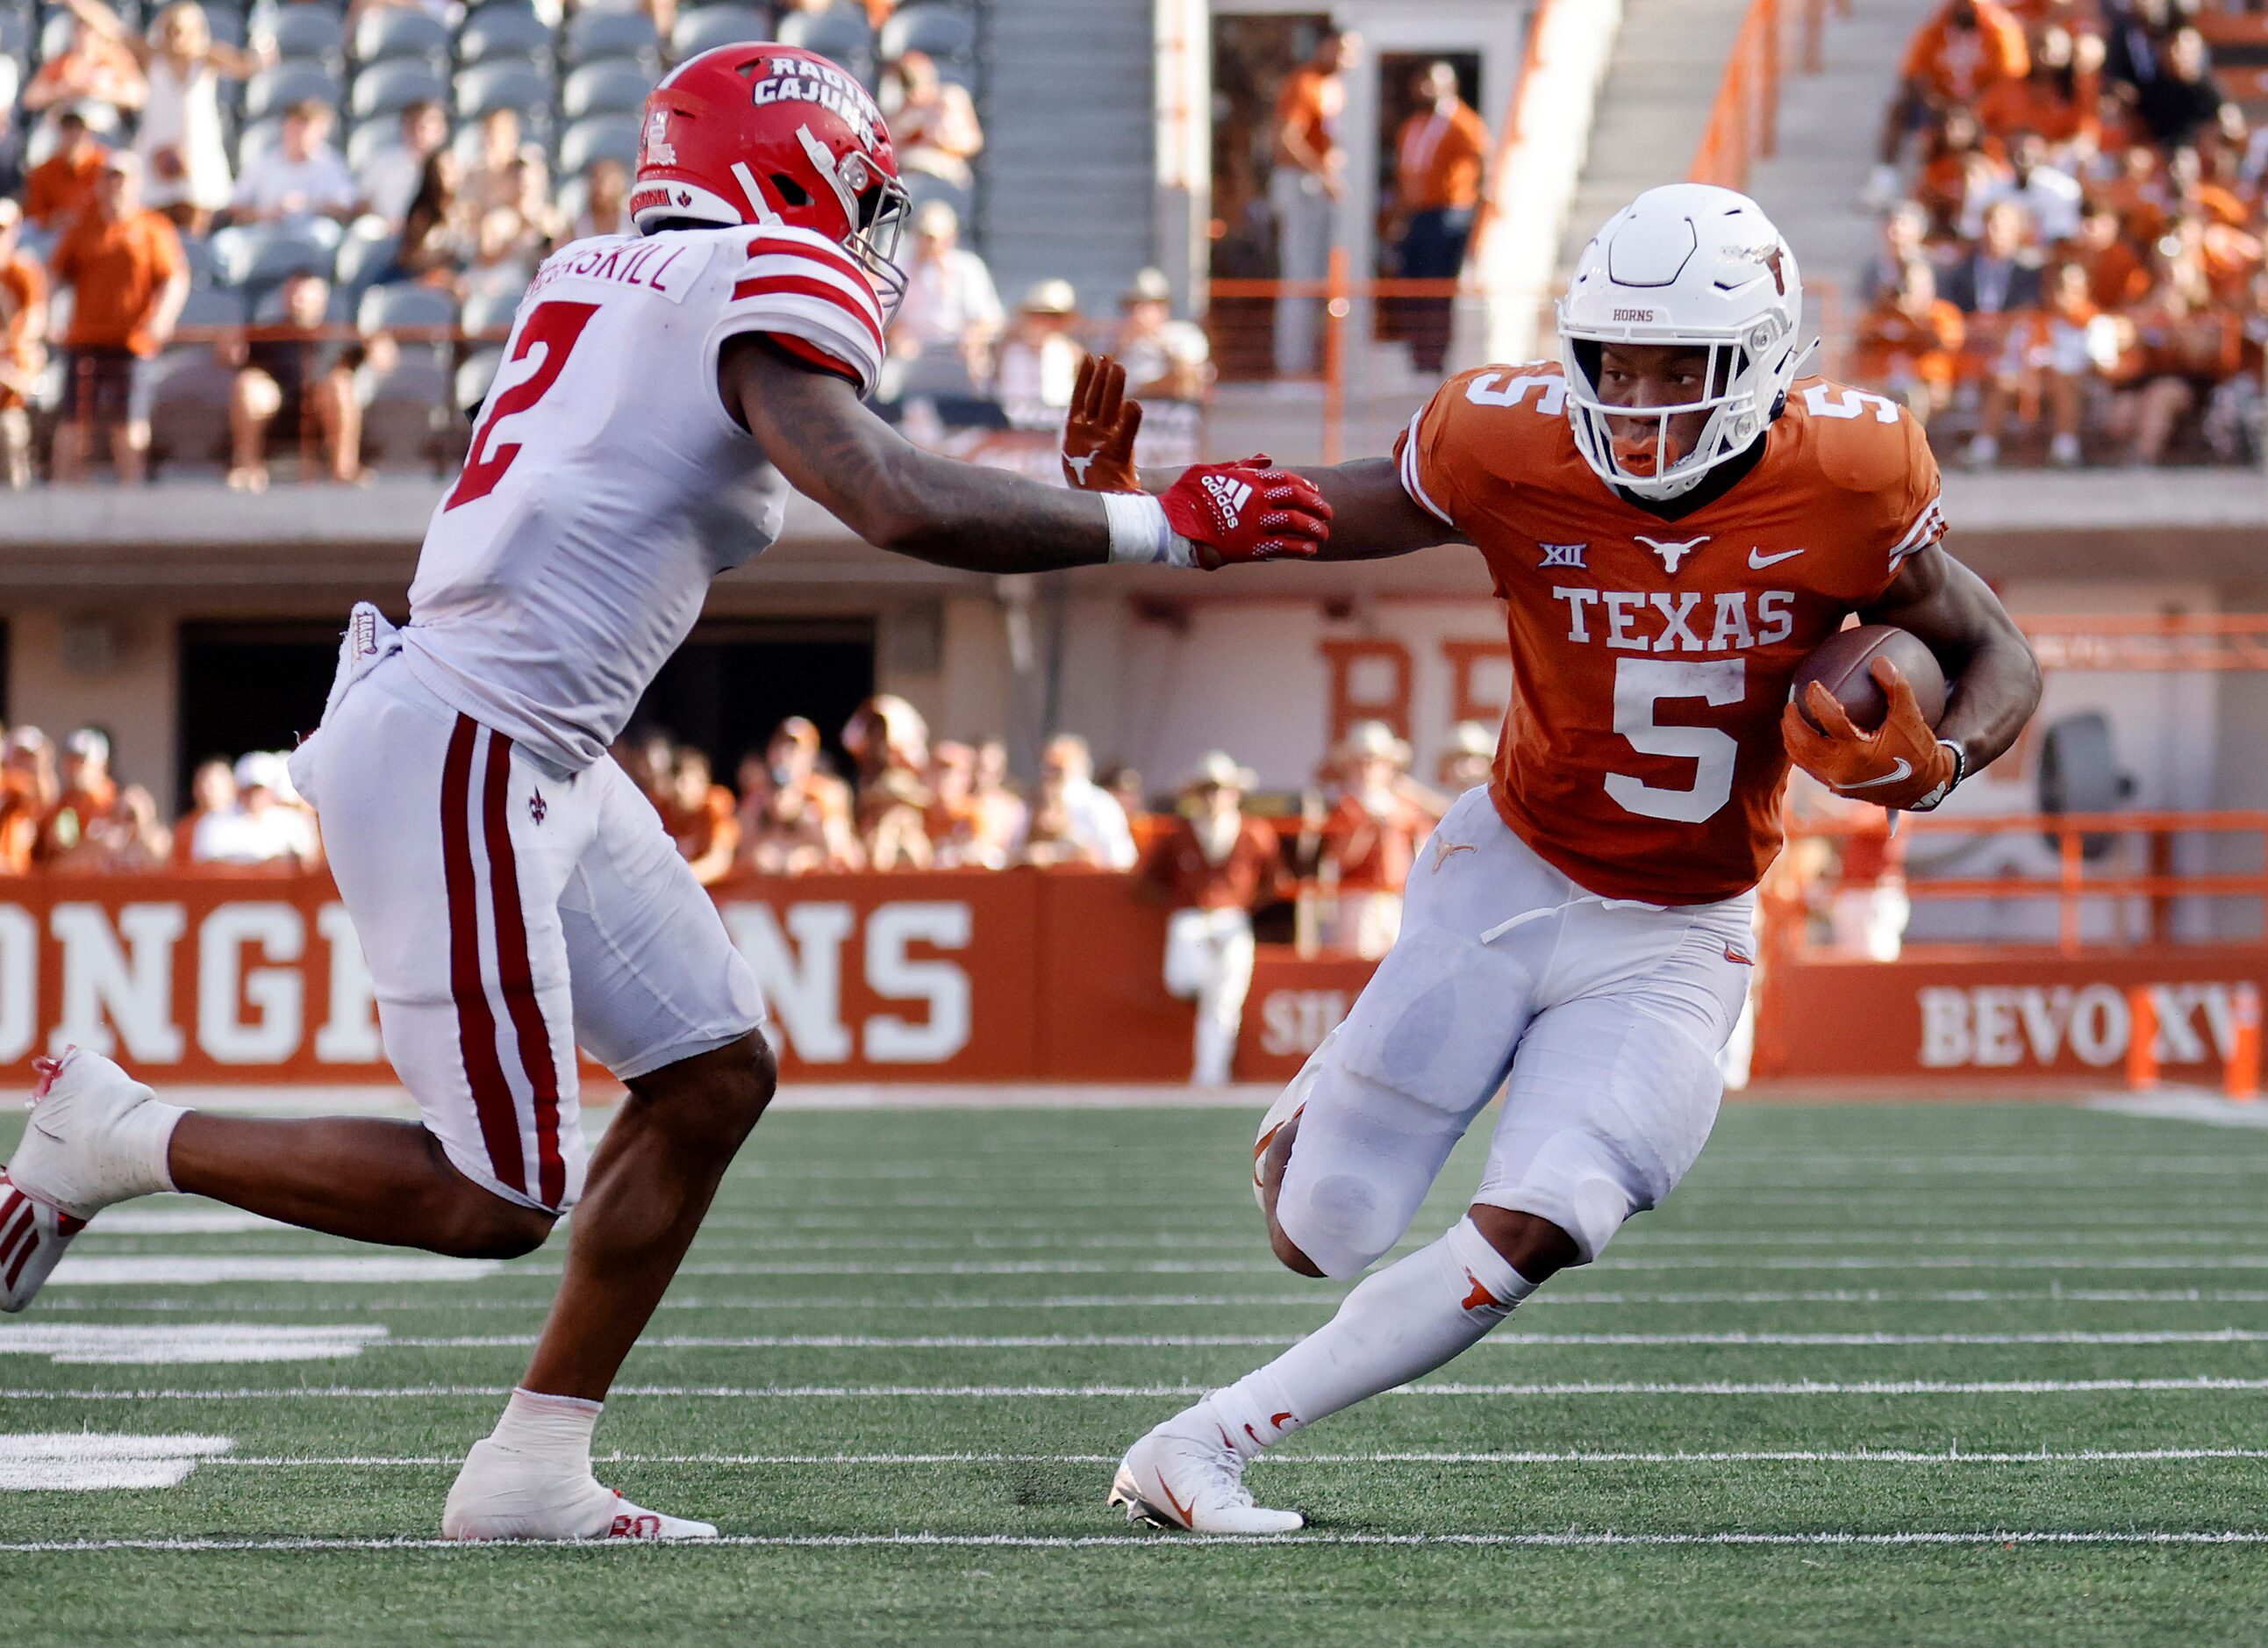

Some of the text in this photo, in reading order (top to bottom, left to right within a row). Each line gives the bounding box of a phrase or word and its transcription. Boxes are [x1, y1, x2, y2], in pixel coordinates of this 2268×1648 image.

[754, 77, 875, 154] CAJUNS
[1613, 308, 1654, 323] HORNS
[442, 300, 604, 514] 2
[1464, 372, 1568, 416] 5
[1801, 383, 1900, 424] 5
[1200, 475, 1240, 530] adidas
[1537, 542, 1587, 569] XII
[1552, 585, 1796, 653] TEXAS
[1603, 656, 1746, 824] 5
[1919, 984, 2130, 1068] BEVO
